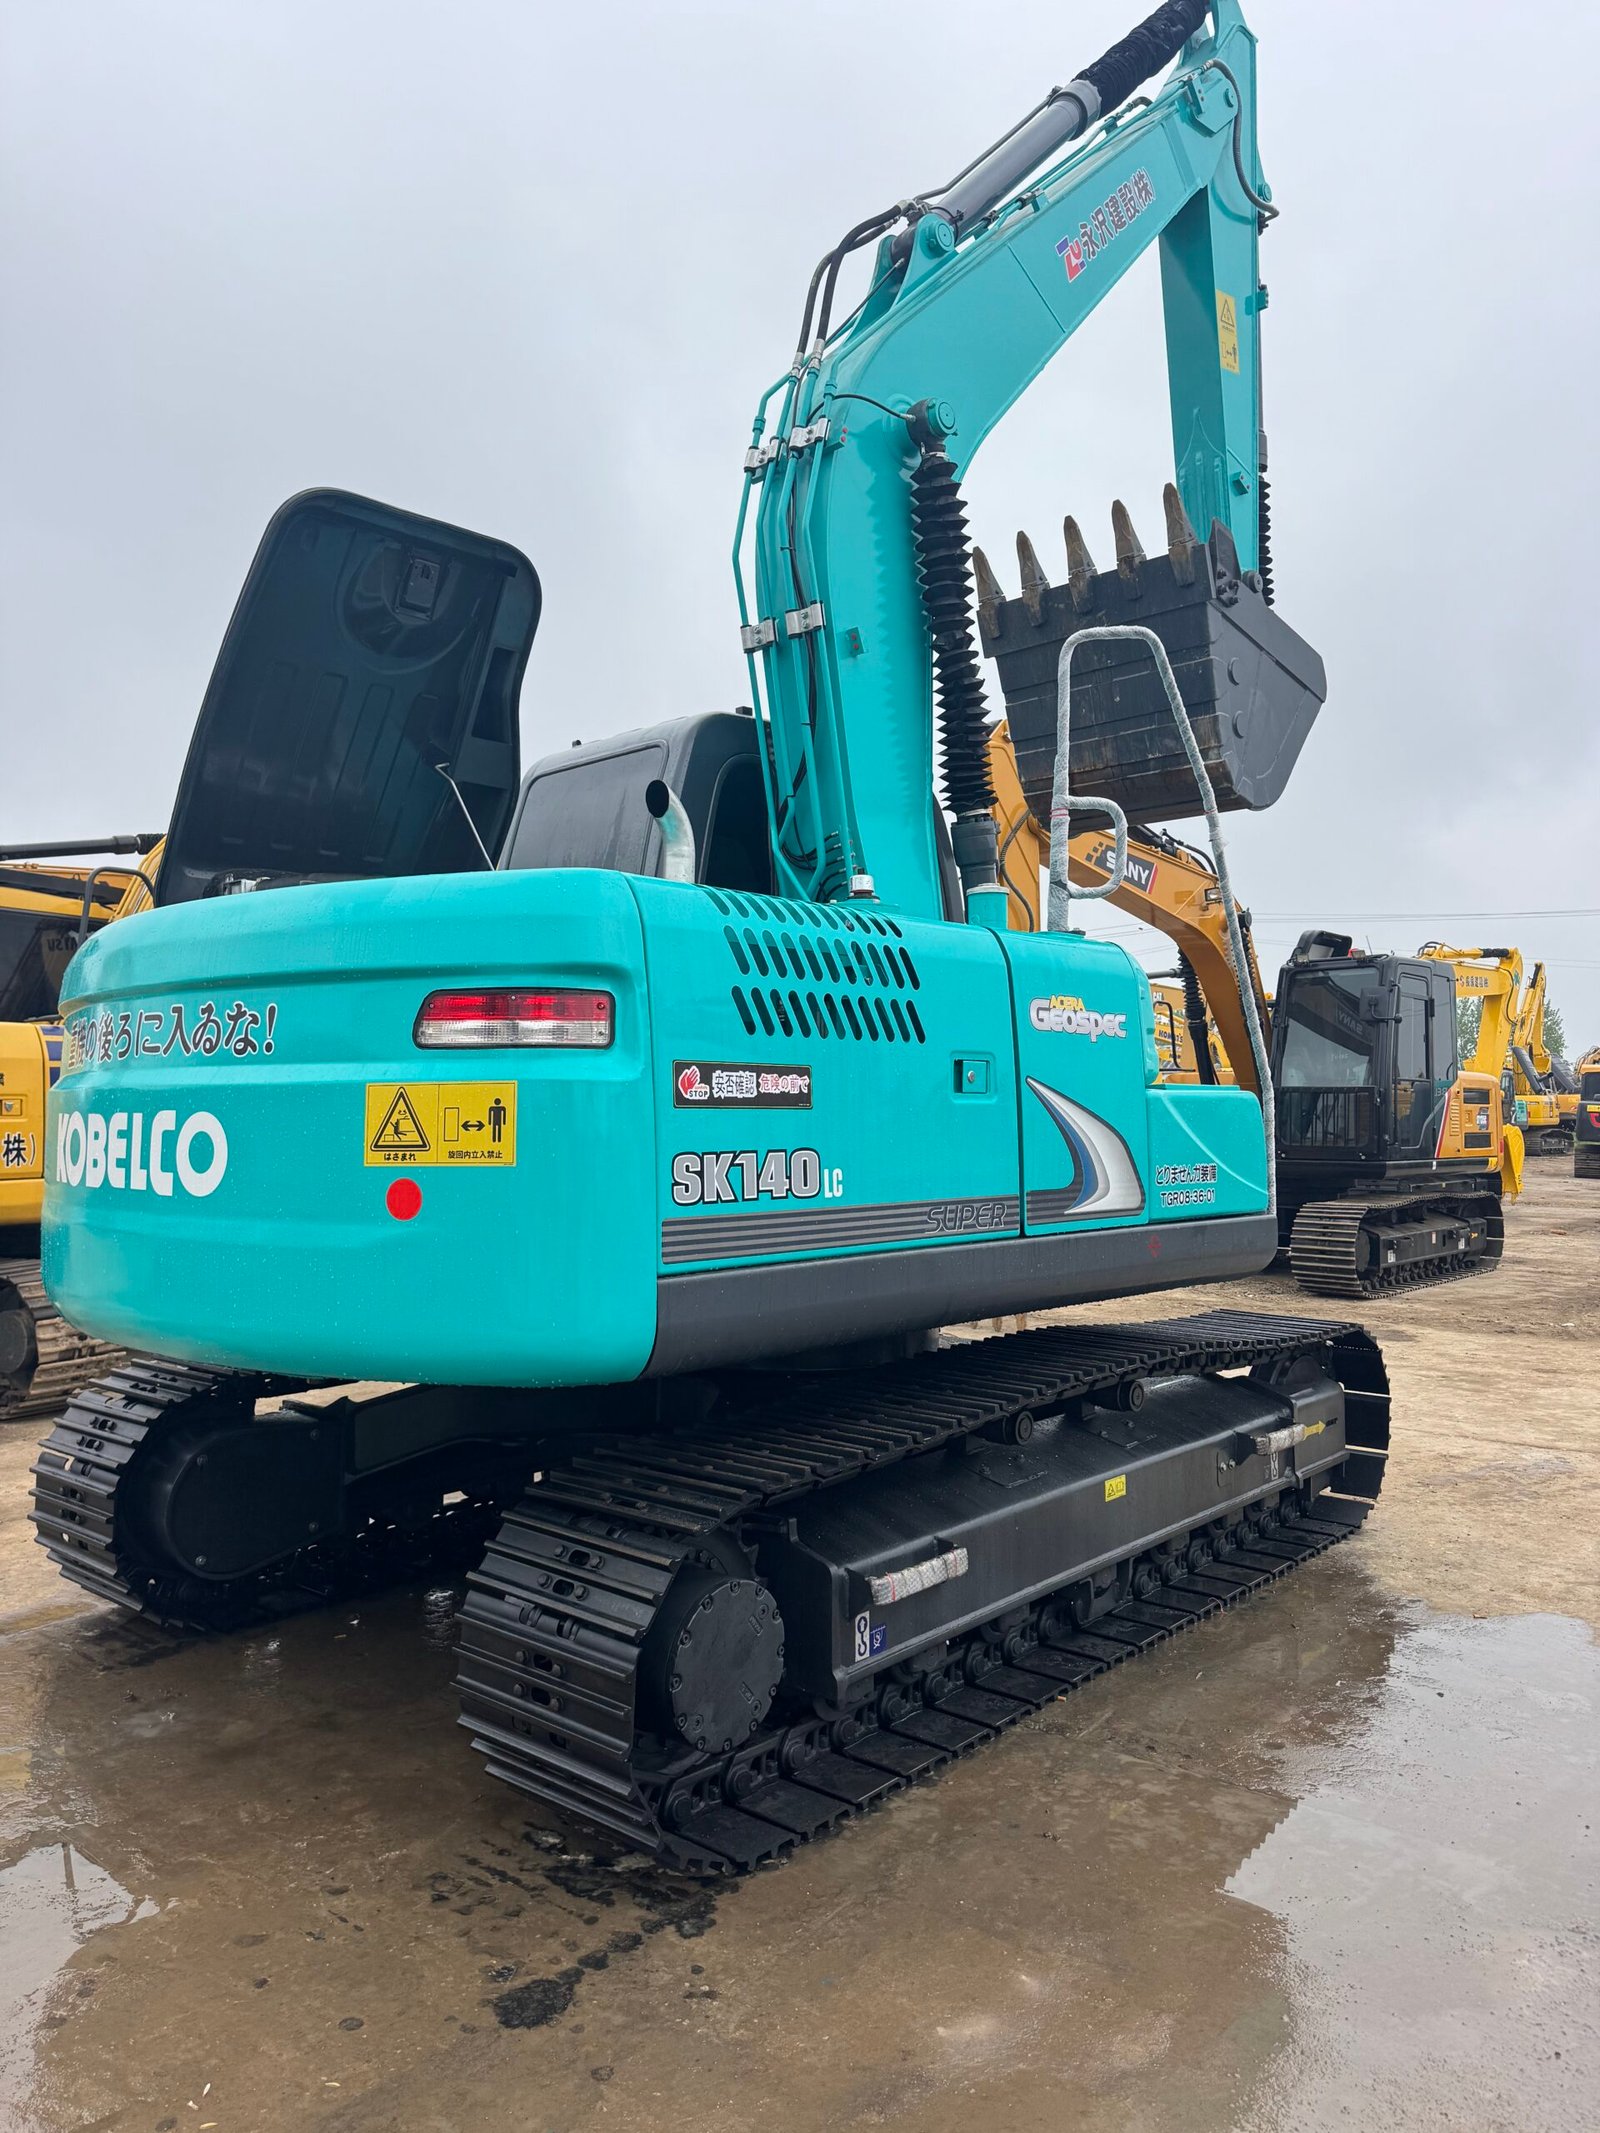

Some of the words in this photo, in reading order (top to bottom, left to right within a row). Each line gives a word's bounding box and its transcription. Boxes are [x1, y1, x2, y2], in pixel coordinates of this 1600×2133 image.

[1106, 850, 1150, 885] SNY
[1050, 994, 1086, 1012] ACERA
[688, 1089, 709, 1098] STOP
[56, 1110, 229, 1197] KOBELCO
[383, 1152, 417, 1162] はさまれ
[447, 1150, 503, 1160] 旋回内立入禁止
[672, 1147, 821, 1207] SK140
[823, 1168, 843, 1198] LC
[926, 1202, 1007, 1234] SUPER
